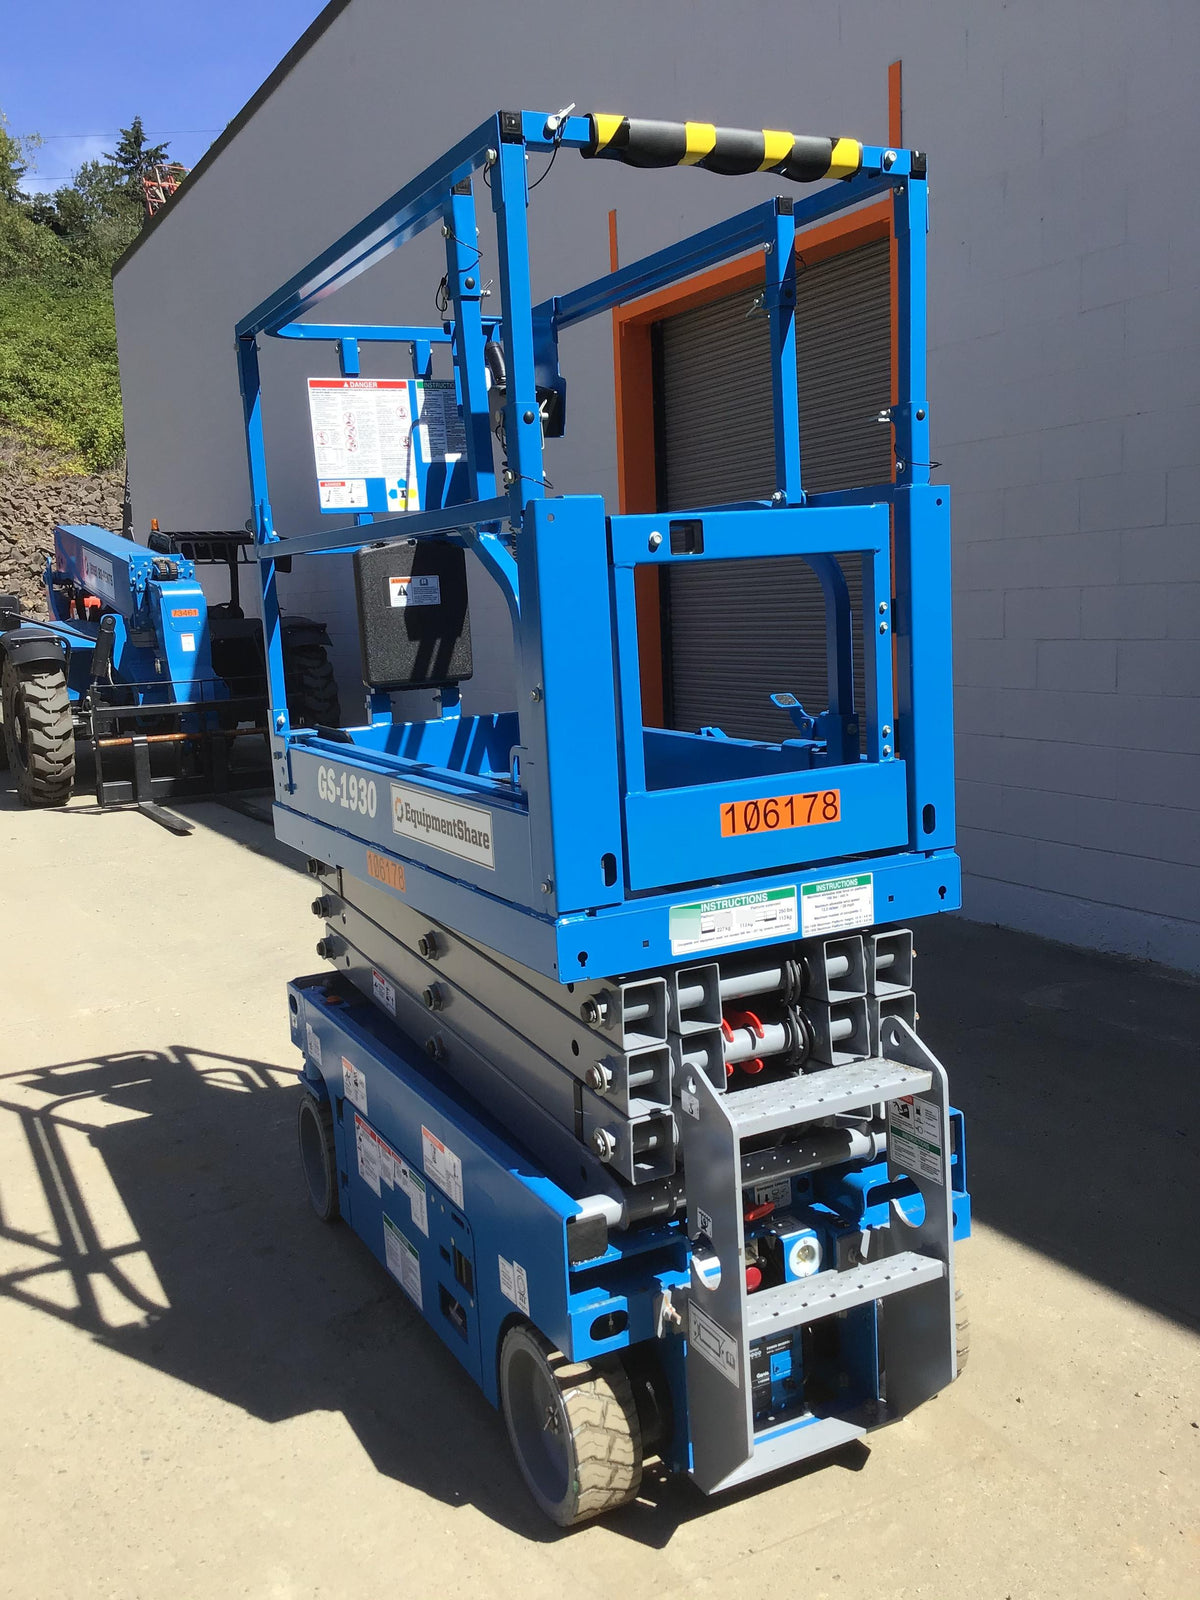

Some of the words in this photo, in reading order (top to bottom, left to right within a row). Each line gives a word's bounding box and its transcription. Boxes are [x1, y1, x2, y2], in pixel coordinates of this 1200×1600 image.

[173, 609, 197, 617] 73461
[317, 765, 377, 818] GS-1930
[404, 802, 491, 850] EquipmentShare
[725, 791, 839, 834] 106178
[367, 853, 405, 891] 106178
[816, 878, 859, 892] INSTRUCTIONS
[700, 892, 768, 913] INSTRUCTIONS
